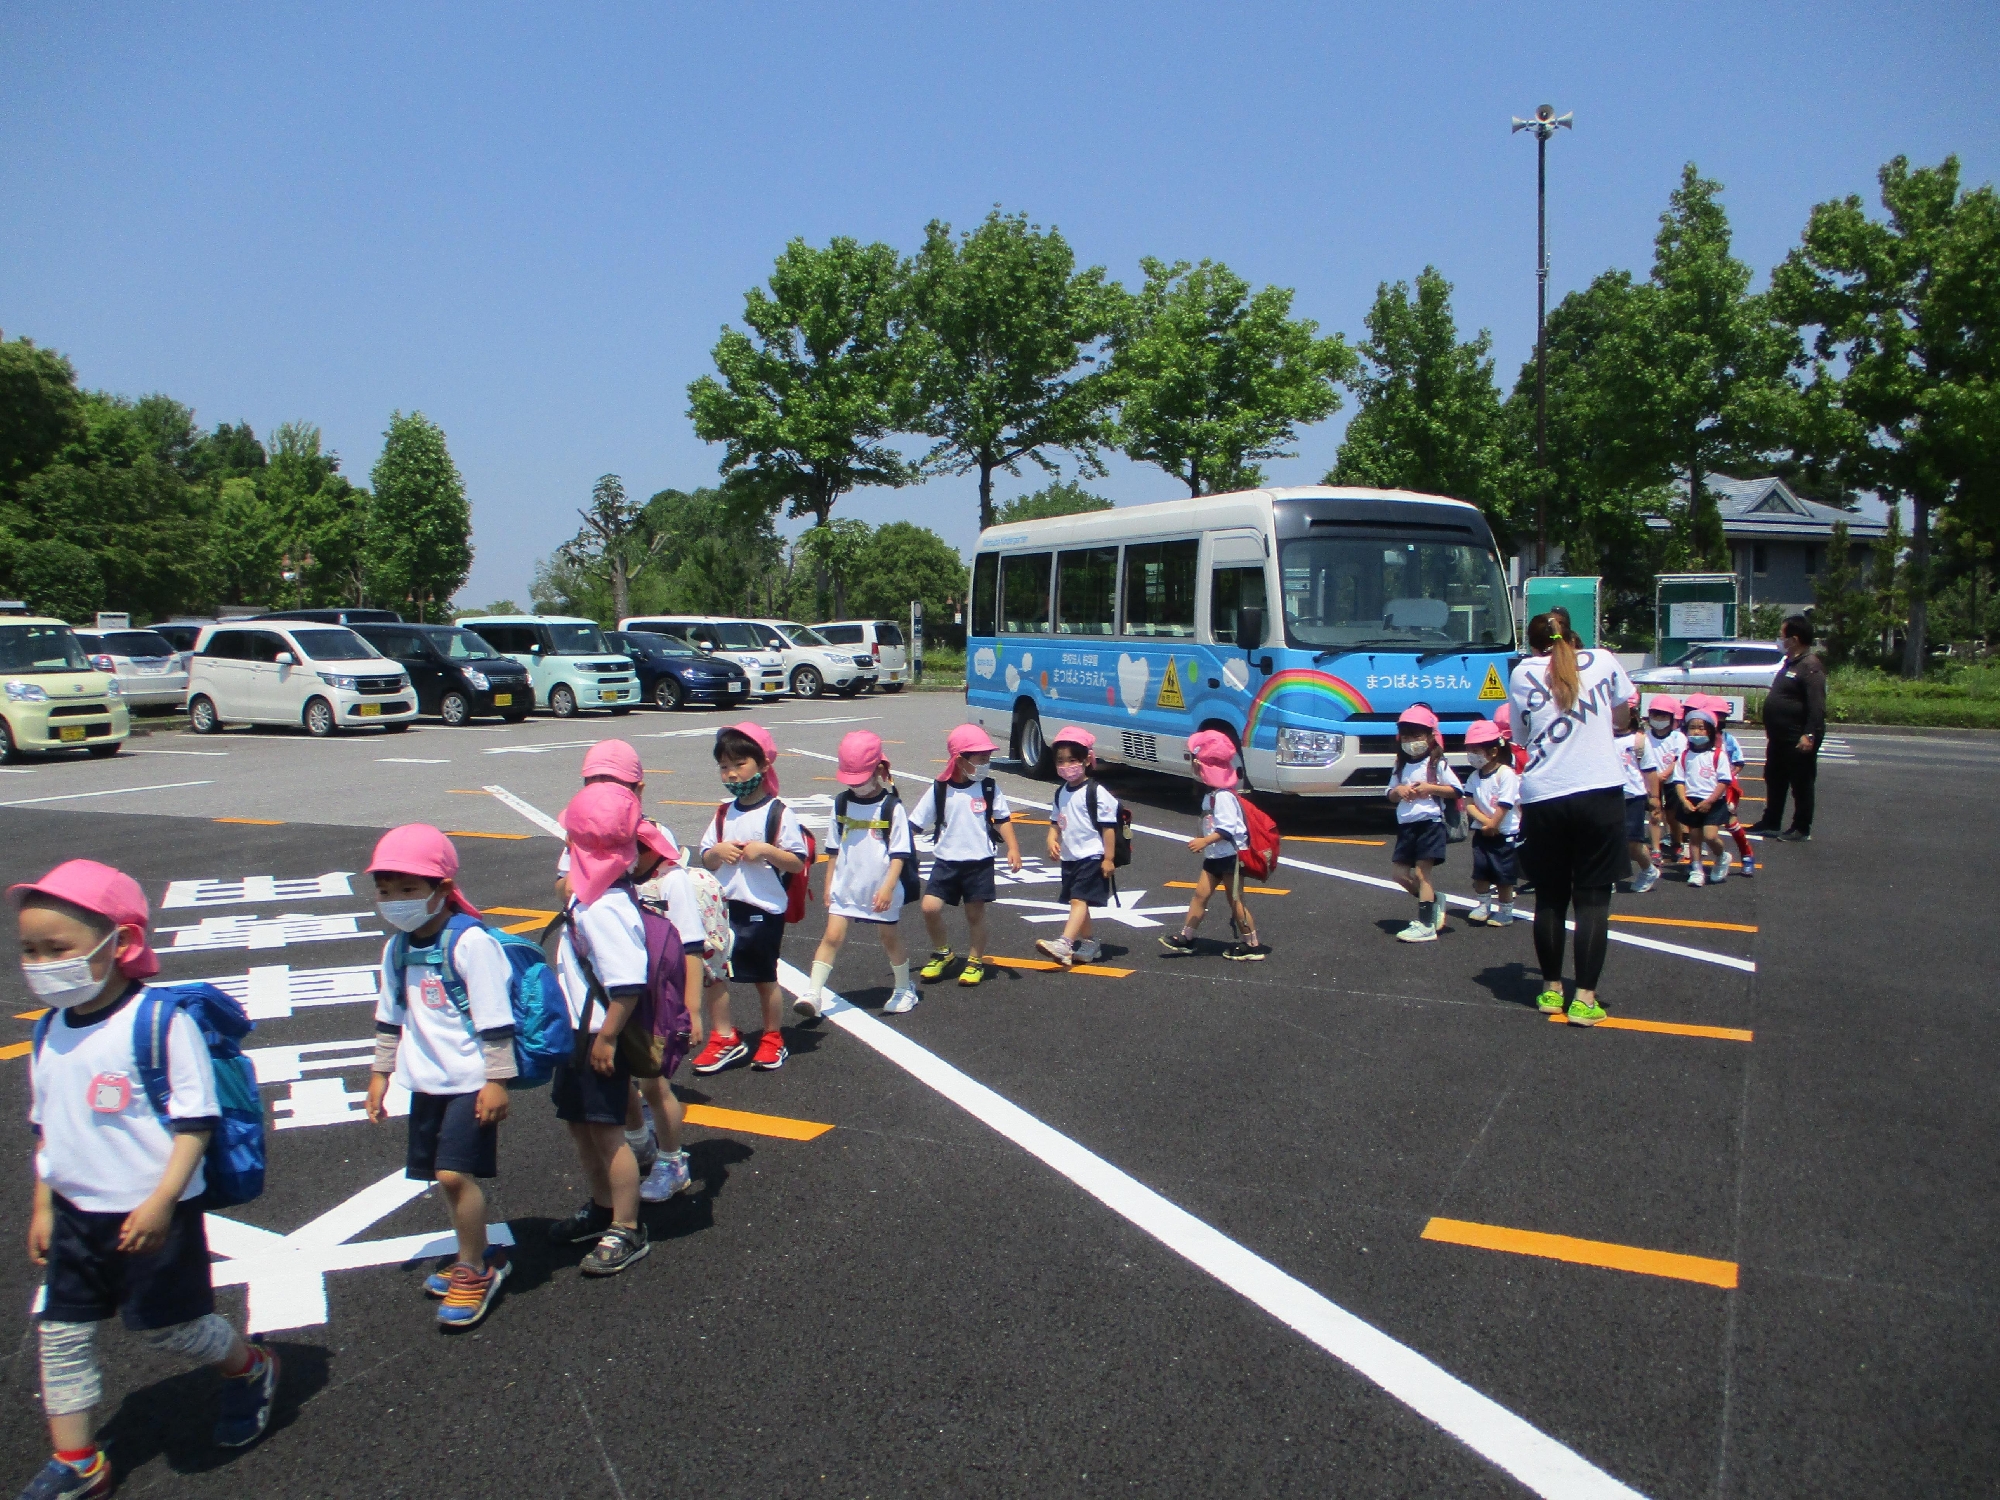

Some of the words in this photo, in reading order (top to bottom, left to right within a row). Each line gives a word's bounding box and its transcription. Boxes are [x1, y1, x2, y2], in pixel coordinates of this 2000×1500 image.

[1053, 668, 1107, 687] まつばようちえん
[1365, 673, 1472, 690] まつばようちえん
